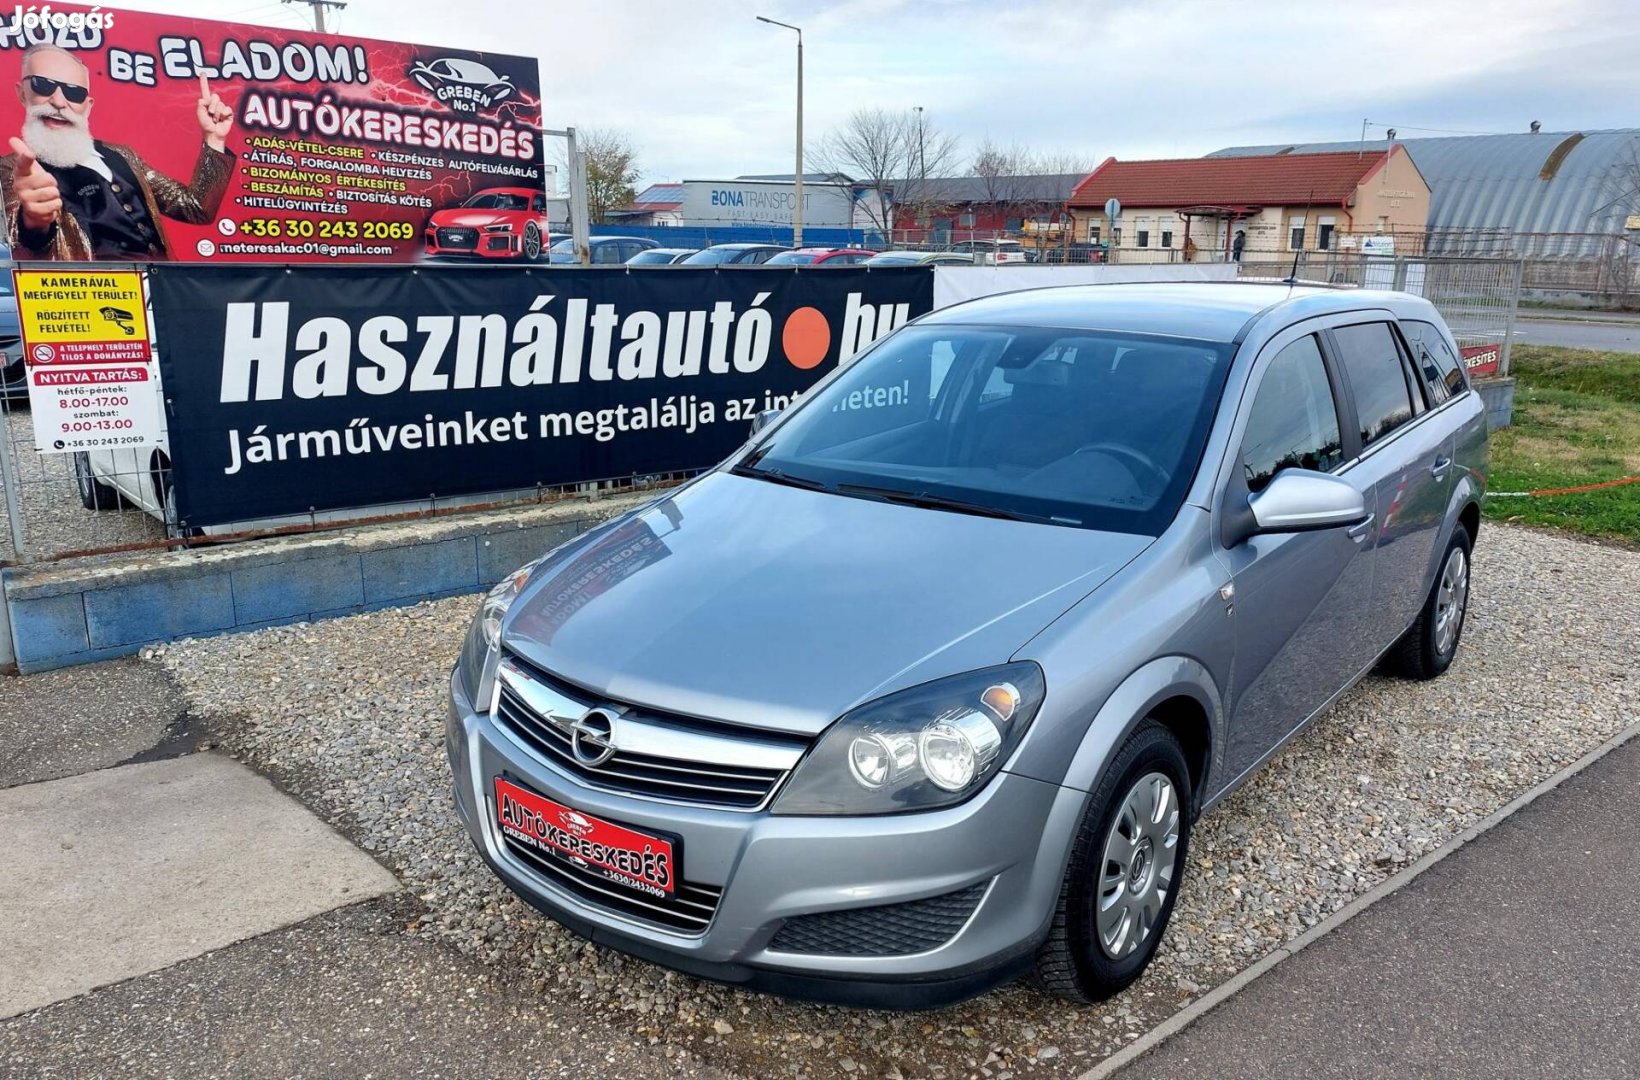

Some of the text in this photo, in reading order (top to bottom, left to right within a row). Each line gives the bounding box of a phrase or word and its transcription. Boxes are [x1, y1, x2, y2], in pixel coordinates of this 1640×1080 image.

[109, 49, 156, 86] BE
[160, 37, 369, 84] ELADOM!
[437, 85, 491, 108] GREBEN
[453, 99, 476, 113] No.1
[244, 93, 535, 161] AUTÓKERESKEDÉS
[253, 136, 538, 179] ADÁS-VÉTEL-CSERE KÉSZPÉNZES AUTÓFELVÁSÁRLÁS
[250, 151, 432, 181] ÁTÍRÁS, FORGALOMBA HELYEZÉS
[250, 167, 406, 191] BIZOMÁNYOS ÉRTÉKESÍTÉS
[251, 181, 432, 208] BESZÁMÍTÁS BIZTOSÍTÁS KÖTÉS
[243, 196, 348, 214] HITELÜGYINTÉZÉS
[240, 218, 414, 239] +36 30 243 2069
[41, 275, 119, 288] KAMERÁVAL
[24, 289, 138, 300] MEGFIGYELT TERÜLET!
[36, 309, 90, 321] RÖGZÍTETT
[40, 322, 91, 334] FELVÉTEL!
[67, 343, 104, 352] TELEPHELY
[61, 353, 84, 361] TILOS
[94, 351, 144, 361] DOHÁNYZÁS!
[40, 368, 142, 384] NYITVA TARTÁS:
[57, 385, 127, 397] hétfő-péntek:
[59, 396, 129, 409] 8.00-17.00
[73, 410, 119, 419] szombat:
[61, 419, 133, 433] 9.00-13.00
[67, 436, 145, 448] +36 30 243 2069
[224, 410, 528, 475] Járműveinket
[539, 395, 716, 442] megtalálja
[724, 397, 756, 421] az
[502, 793, 669, 888] AUTÓKERESKEDÉS
[503, 825, 556, 856] GREBEN No.1
